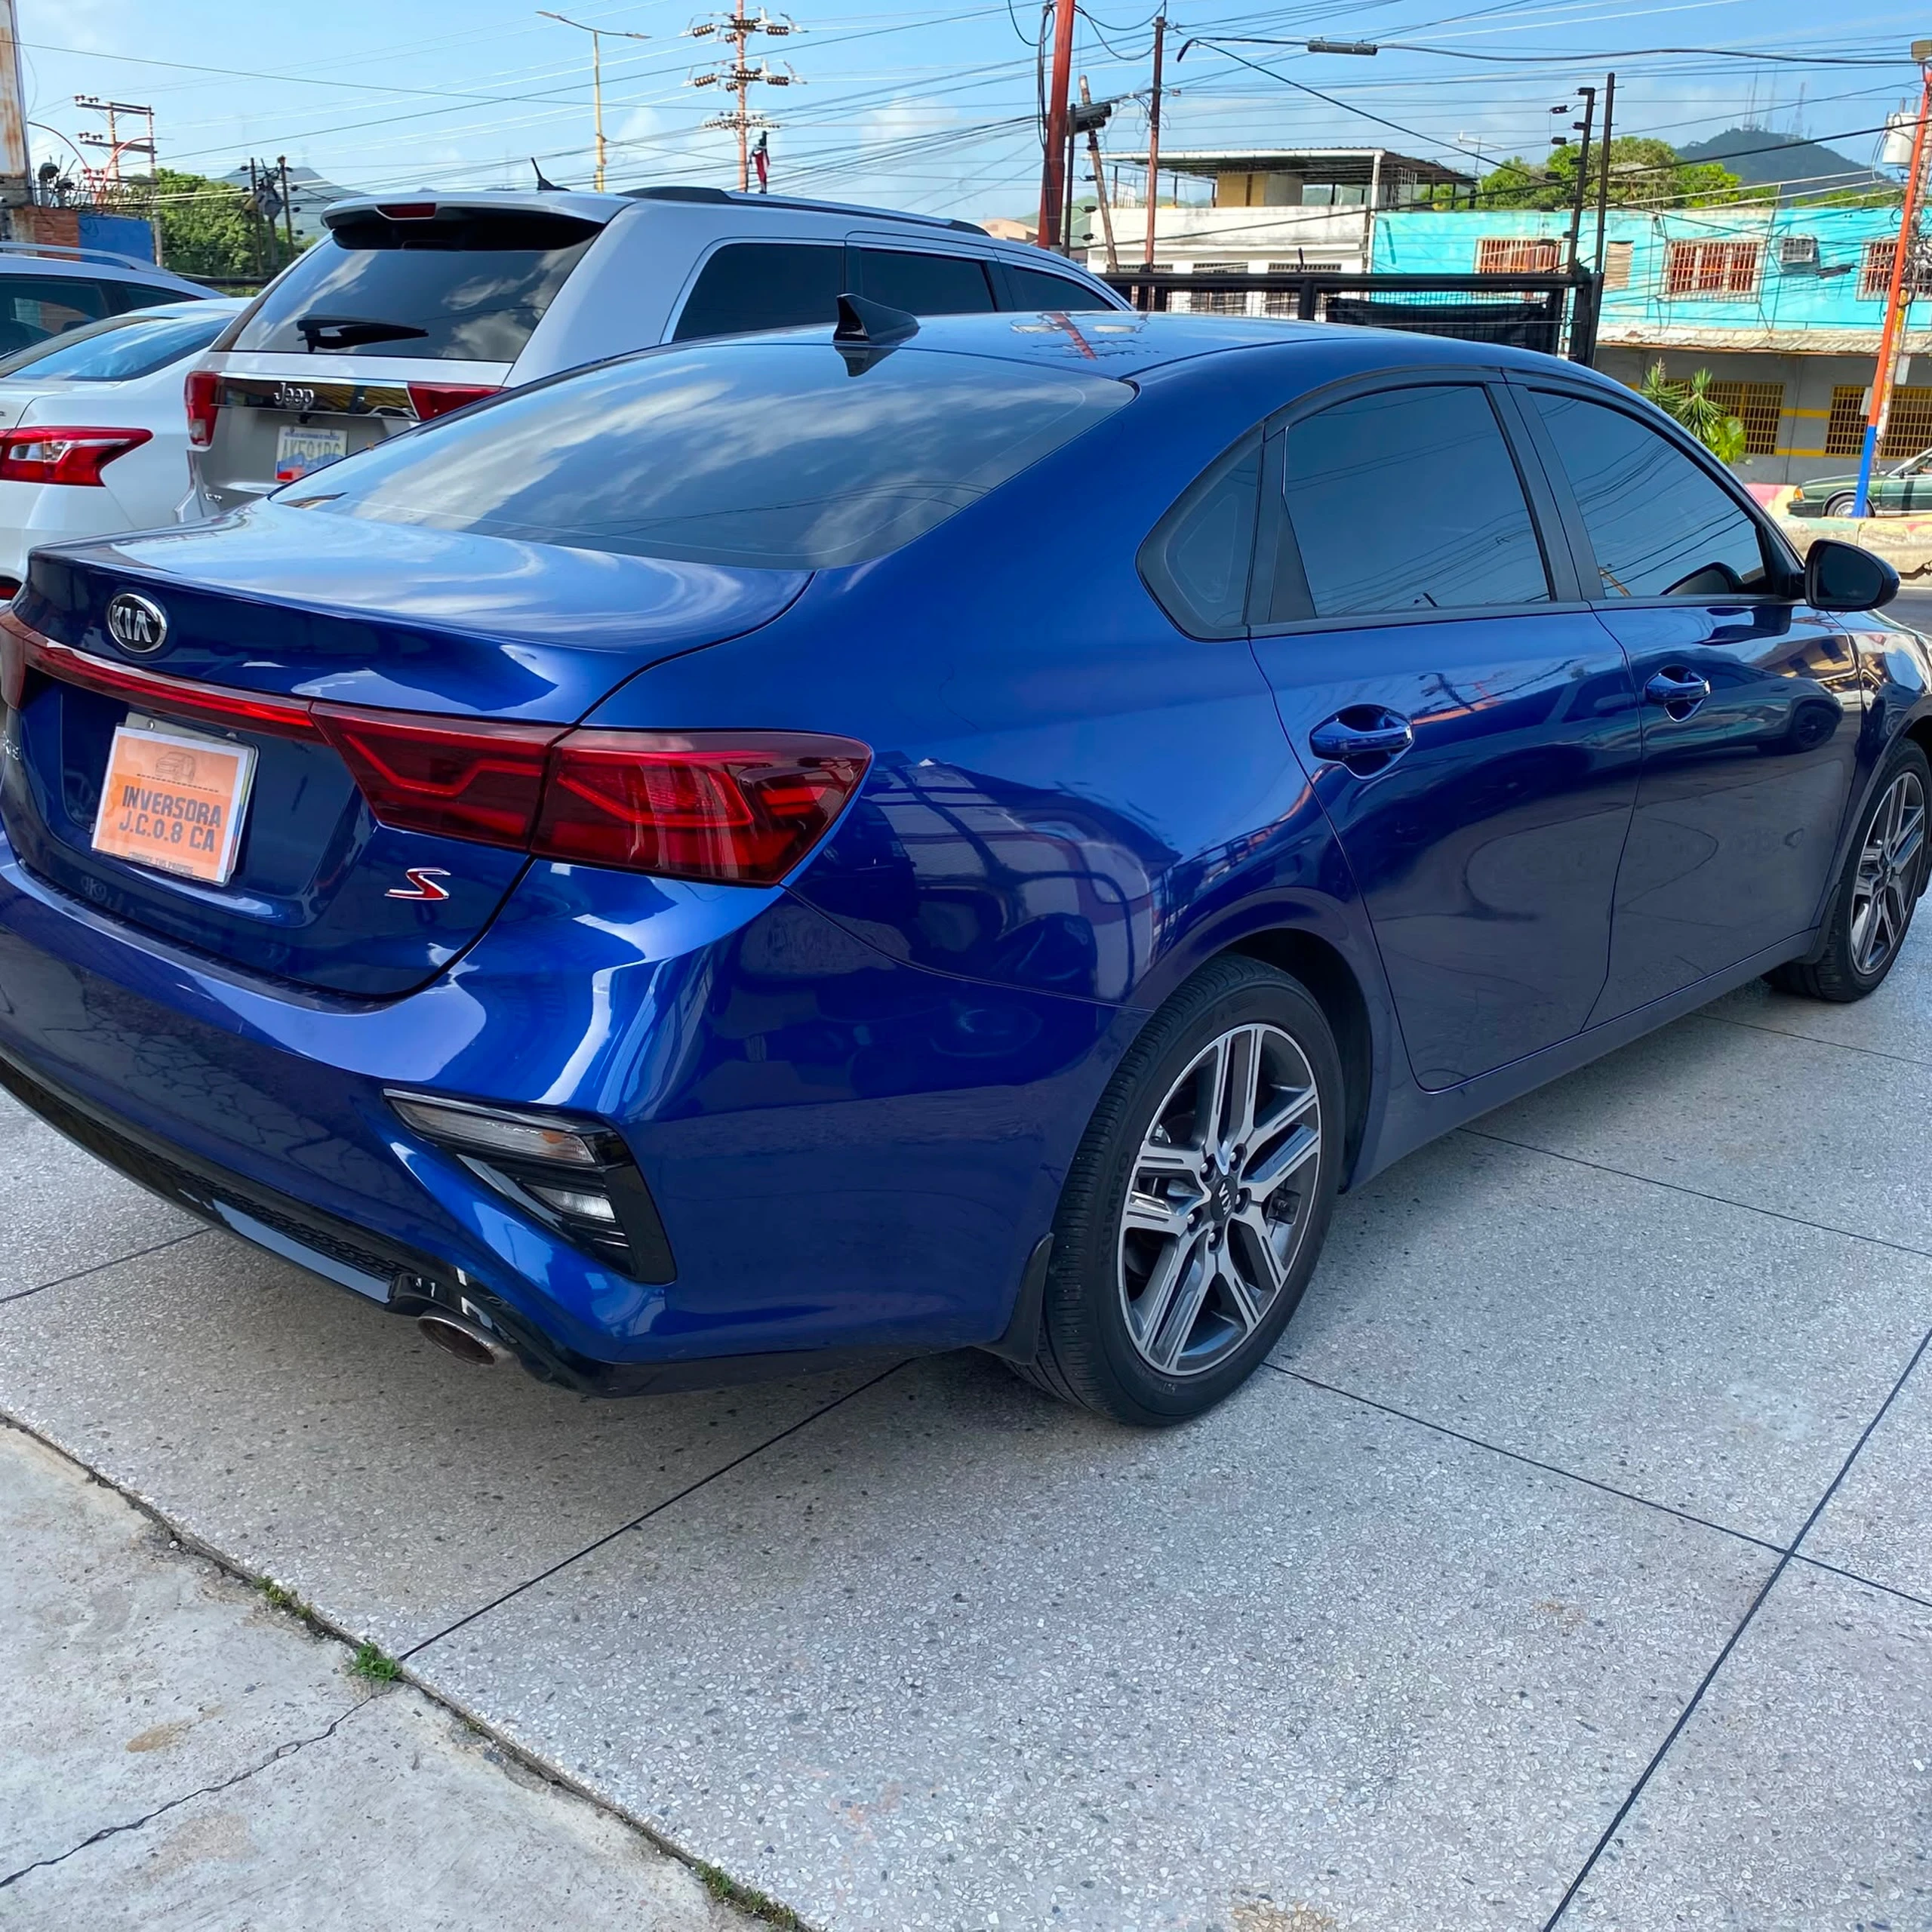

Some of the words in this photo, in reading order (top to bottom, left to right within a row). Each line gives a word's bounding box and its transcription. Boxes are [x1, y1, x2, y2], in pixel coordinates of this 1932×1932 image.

[274, 382, 314, 411] Jeep
[112, 605, 152, 642] KIA
[123, 786, 221, 828] INVERSORA
[189, 826, 215, 852] CA
[384, 866, 451, 900] S
[1100, 1152, 1131, 1269] KUMHO
[1219, 1183, 1232, 1215] KIA
